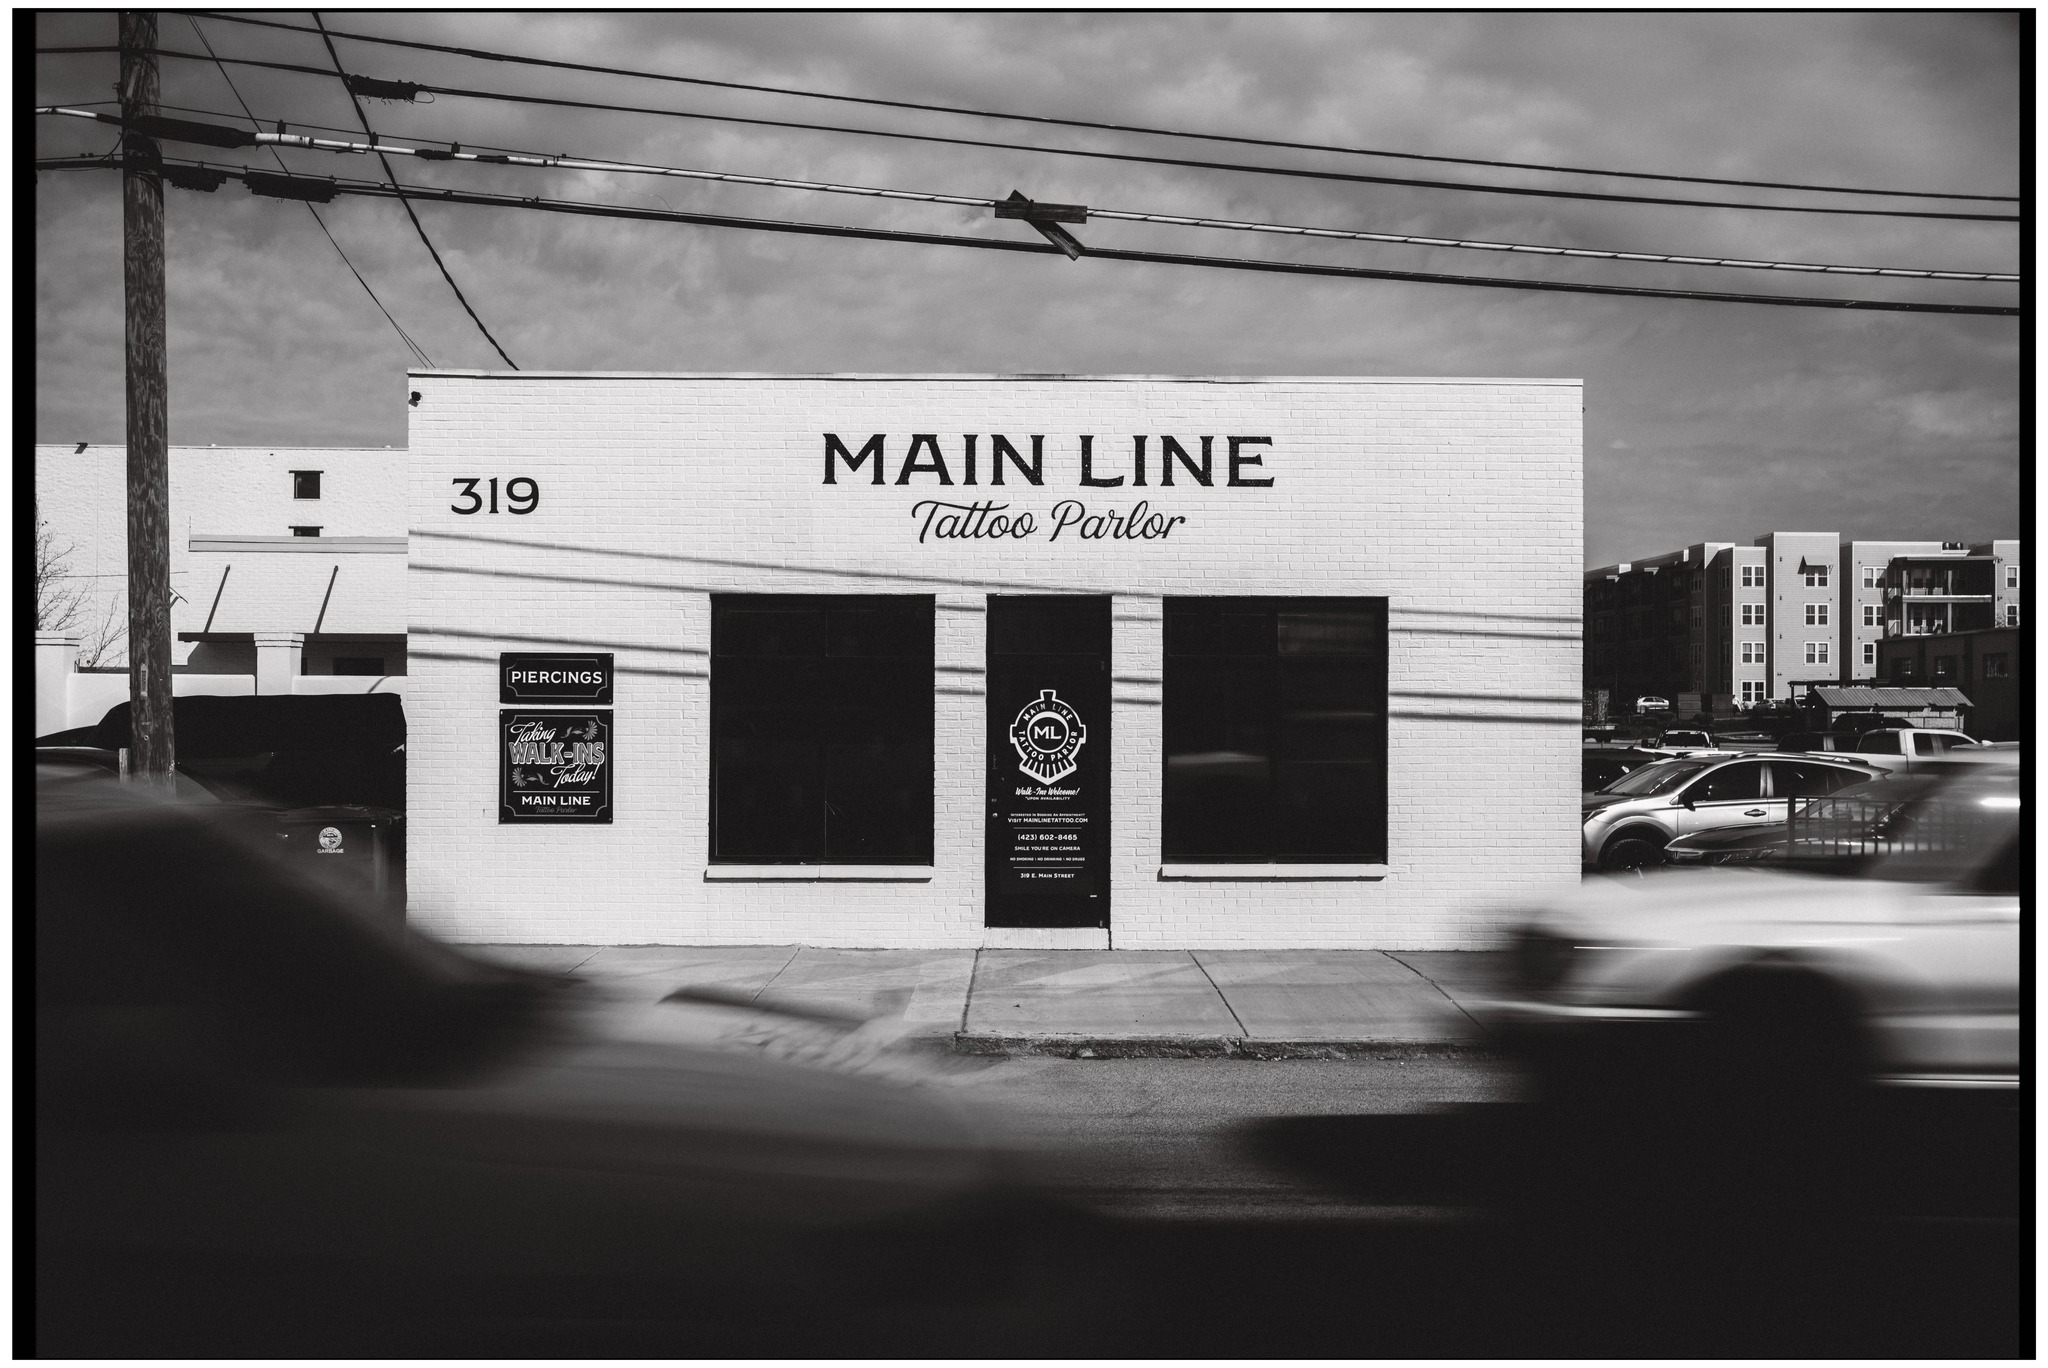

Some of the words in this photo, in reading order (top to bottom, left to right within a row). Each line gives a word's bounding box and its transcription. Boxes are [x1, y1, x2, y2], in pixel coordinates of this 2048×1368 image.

[822, 433, 1046, 486] MAIN
[1079, 435, 1275, 488] LINE
[451, 476, 540, 515] 319
[911, 500, 1038, 544] Tattoo
[1049, 500, 1187, 542] Parlor
[511, 671, 603, 684] PIERCINGS
[1023, 703, 1046, 721] MAIN
[1052, 703, 1073, 721] LINE
[510, 721, 557, 747] Taking
[1033, 726, 1062, 739] ML
[508, 742, 605, 765] WALK-INS
[1018, 730, 1044, 761] TATTOO
[1050, 731, 1078, 762] PARLOR
[550, 762, 601, 788] Today!
[521, 796, 556, 806] MAIN
[560, 796, 591, 806] LINE
[1015, 787, 1047, 796] Walk-Ins
[1048, 787, 1080, 796] Welcome!
[535, 805, 555, 814] Tattoo
[556, 805, 577, 814] Parlor
